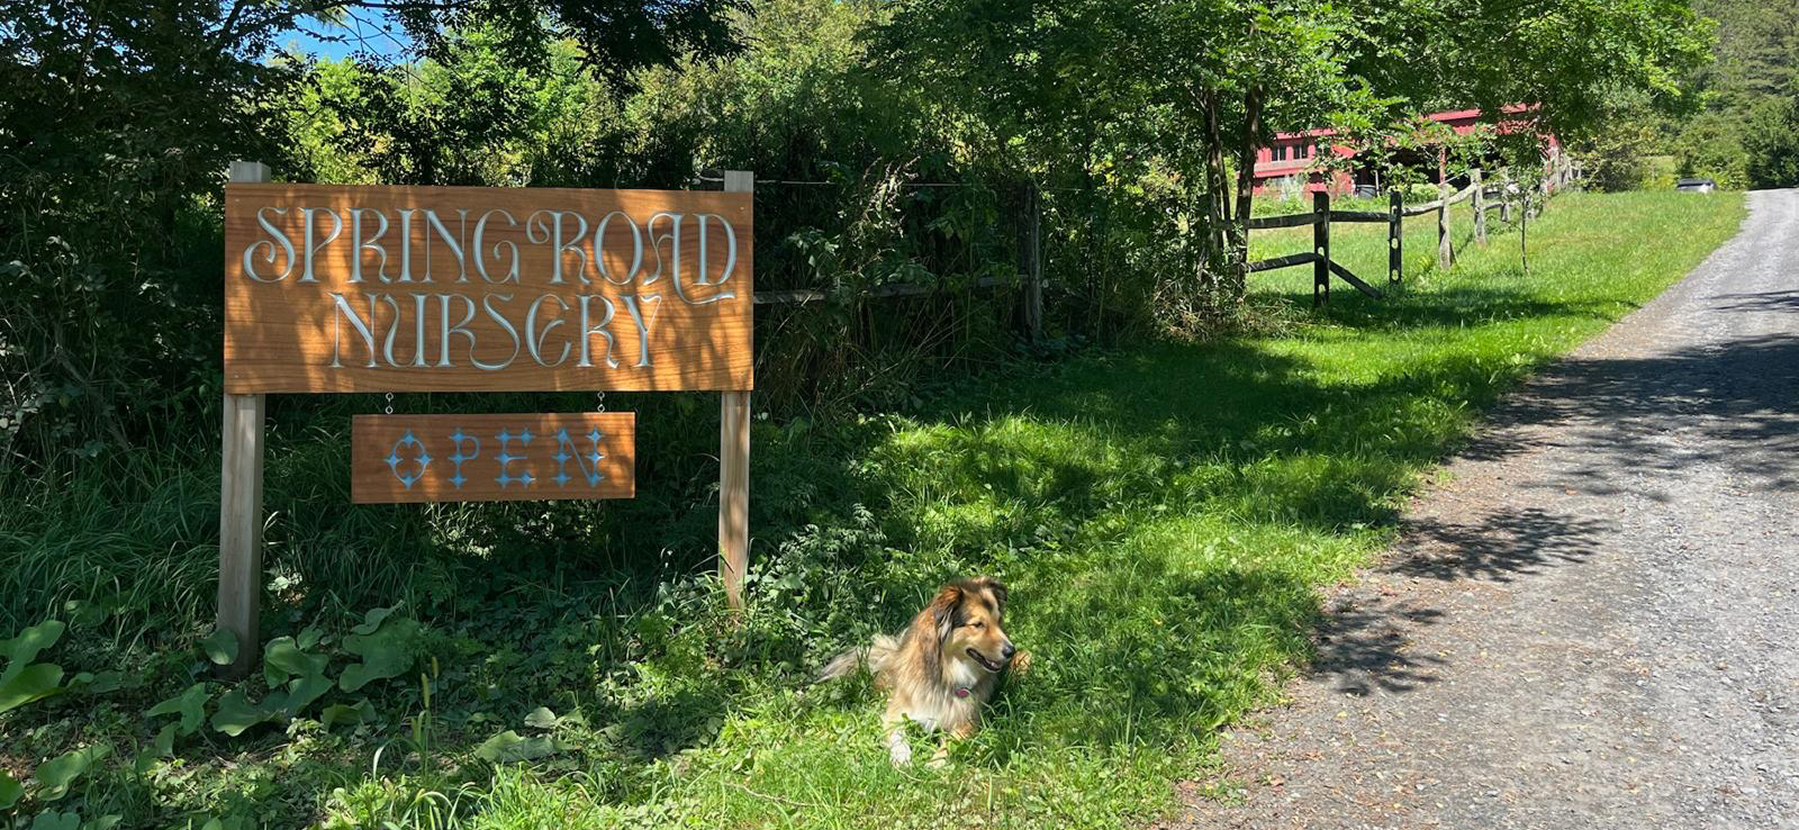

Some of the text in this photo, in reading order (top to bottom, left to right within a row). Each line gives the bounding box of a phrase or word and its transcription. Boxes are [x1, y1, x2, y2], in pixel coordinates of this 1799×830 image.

[243, 206, 737, 305] SPRING ROAD
[328, 292, 663, 370] NURSERY
[383, 425, 605, 490] OPEN
